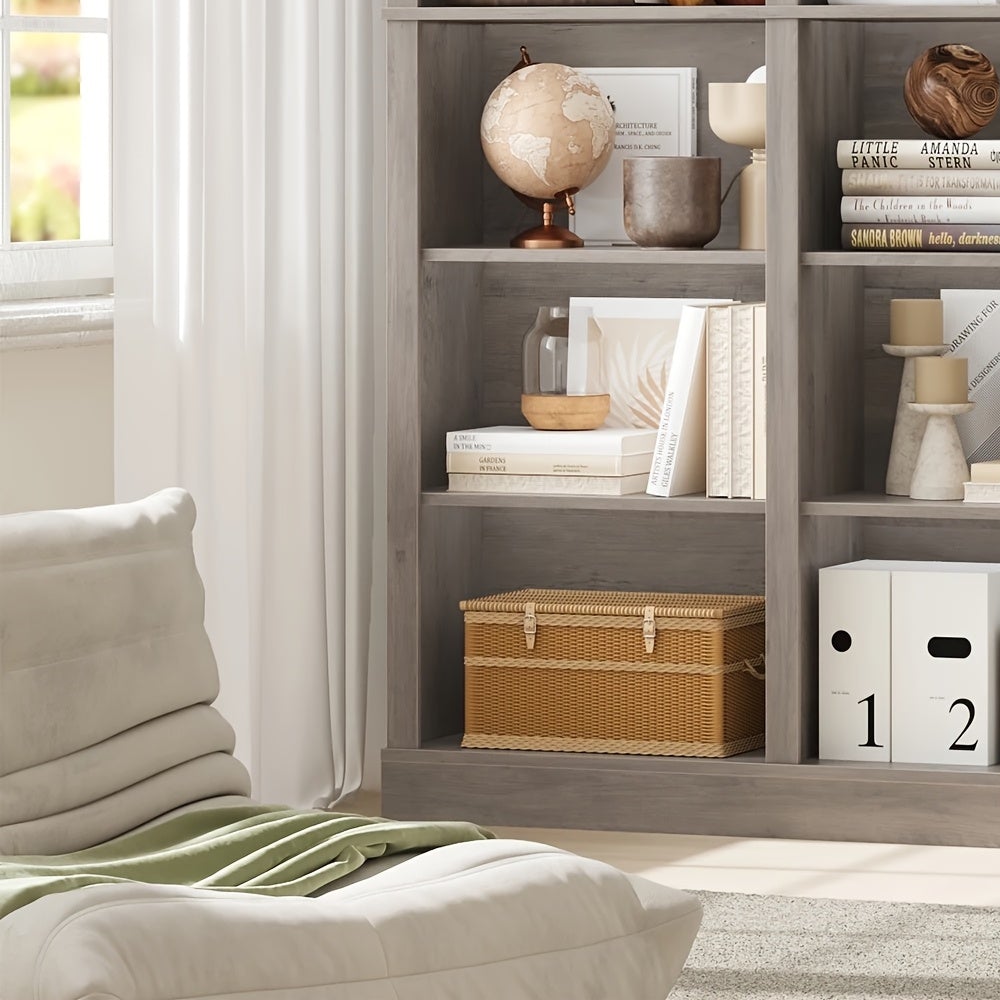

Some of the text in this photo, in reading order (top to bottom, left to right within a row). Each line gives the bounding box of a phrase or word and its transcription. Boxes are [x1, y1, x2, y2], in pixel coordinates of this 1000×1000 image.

[851, 141, 899, 154] LITTLE
[921, 142, 979, 156] AMANDA
[852, 156, 899, 168] PANIC
[928, 156, 972, 169] STERN
[925, 175, 940, 189] FOR
[854, 199, 870, 211] The
[873, 199, 913, 211] Children
[917, 201, 926, 210] in
[851, 229, 888, 248] SANDRA
[889, 229, 923, 248] BROWN
[928, 231, 956, 248] hello,
[949, 299, 1000, 353] DRAWING FOR
[857, 693, 884, 748] 1
[948, 698, 979, 752] 2
